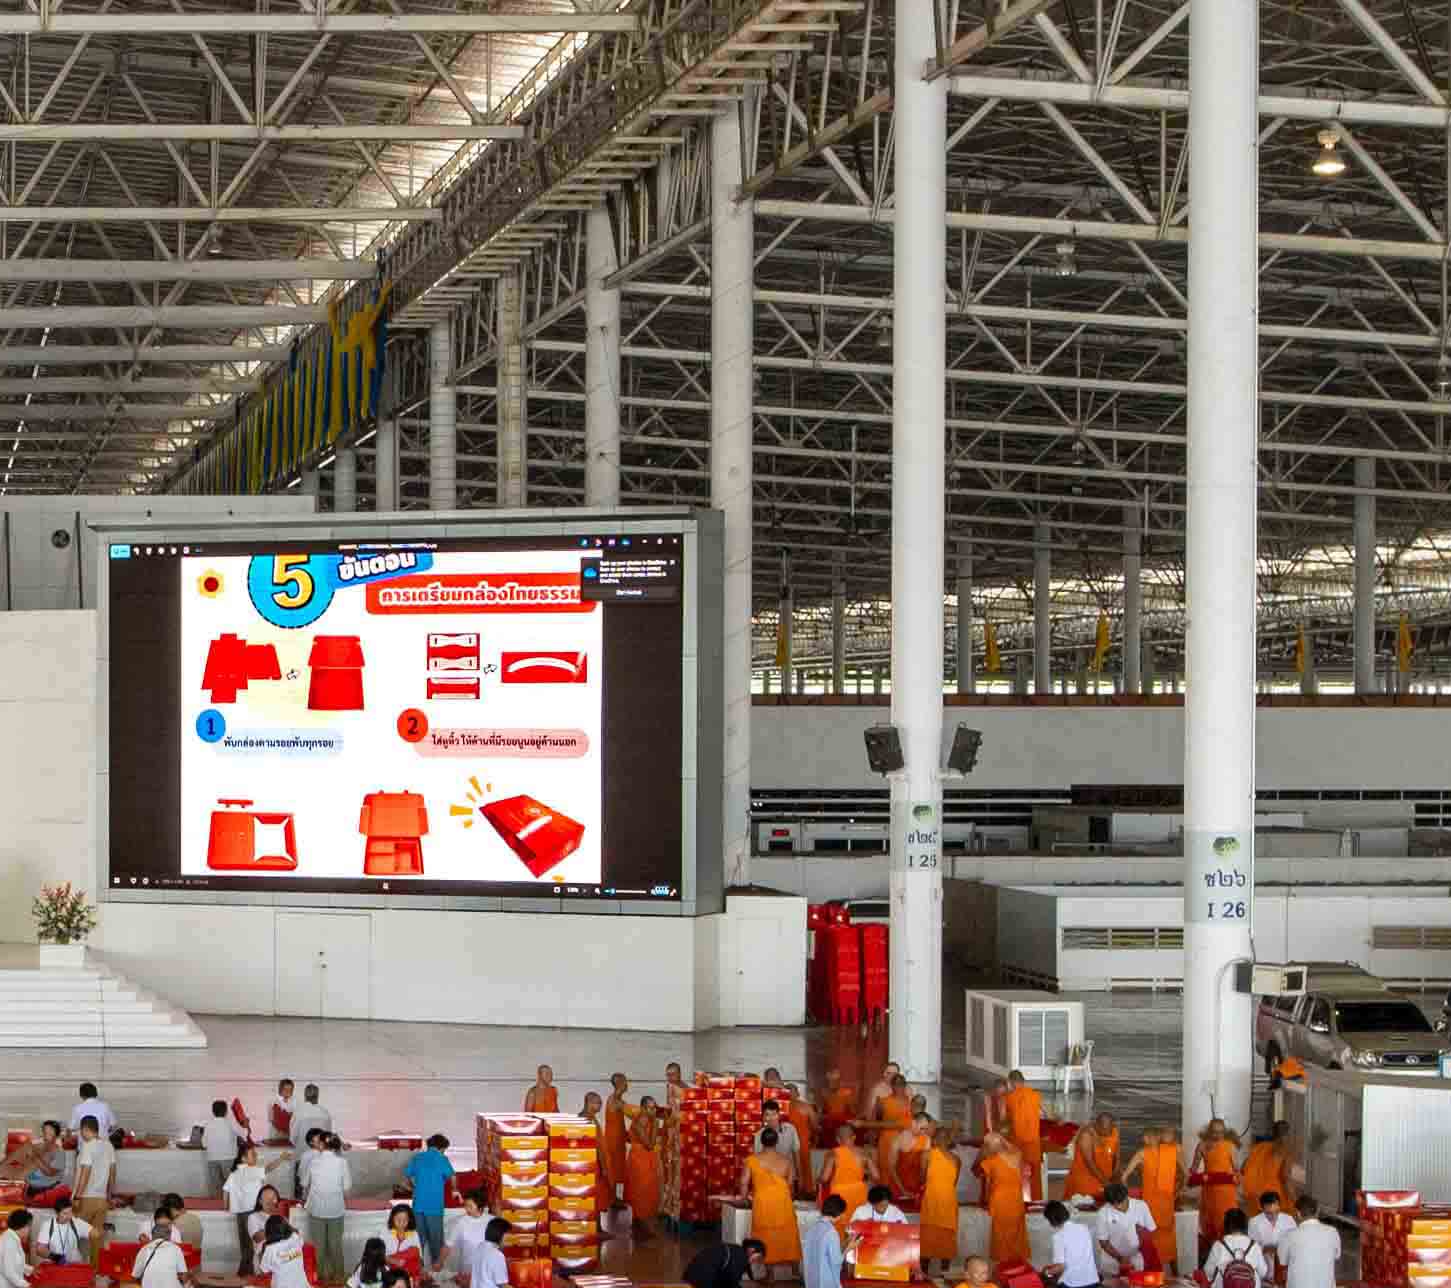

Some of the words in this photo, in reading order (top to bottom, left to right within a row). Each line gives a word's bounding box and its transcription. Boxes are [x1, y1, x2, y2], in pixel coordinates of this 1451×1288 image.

[273, 554, 314, 609] 5
[206, 717, 217, 736] 1
[407, 717, 418, 735] 2
[1222, 901, 1246, 918] 26
